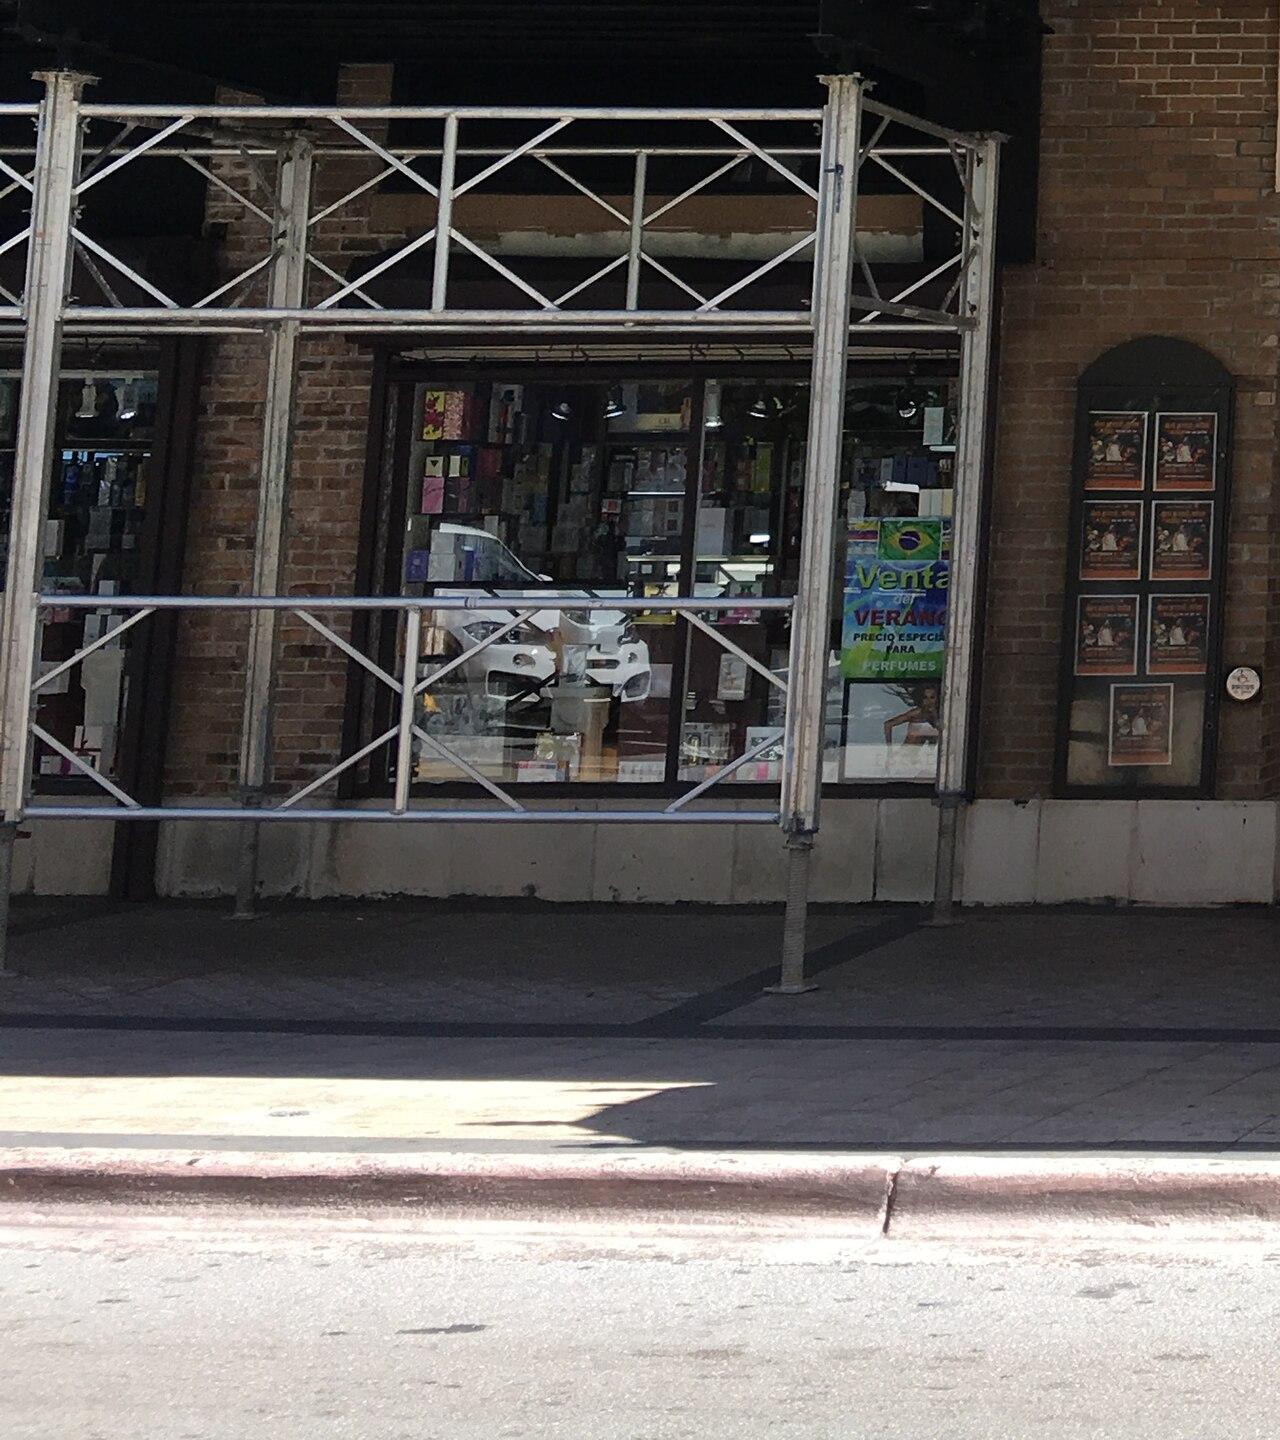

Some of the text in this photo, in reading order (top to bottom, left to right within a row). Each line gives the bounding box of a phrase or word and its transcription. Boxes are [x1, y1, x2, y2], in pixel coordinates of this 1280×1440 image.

[854, 562, 950, 590] Venta
[853, 632, 946, 643] PRECIO ESPECIA
[886, 644, 916, 655] PARA
[862, 660, 937, 672] PERFUMES
